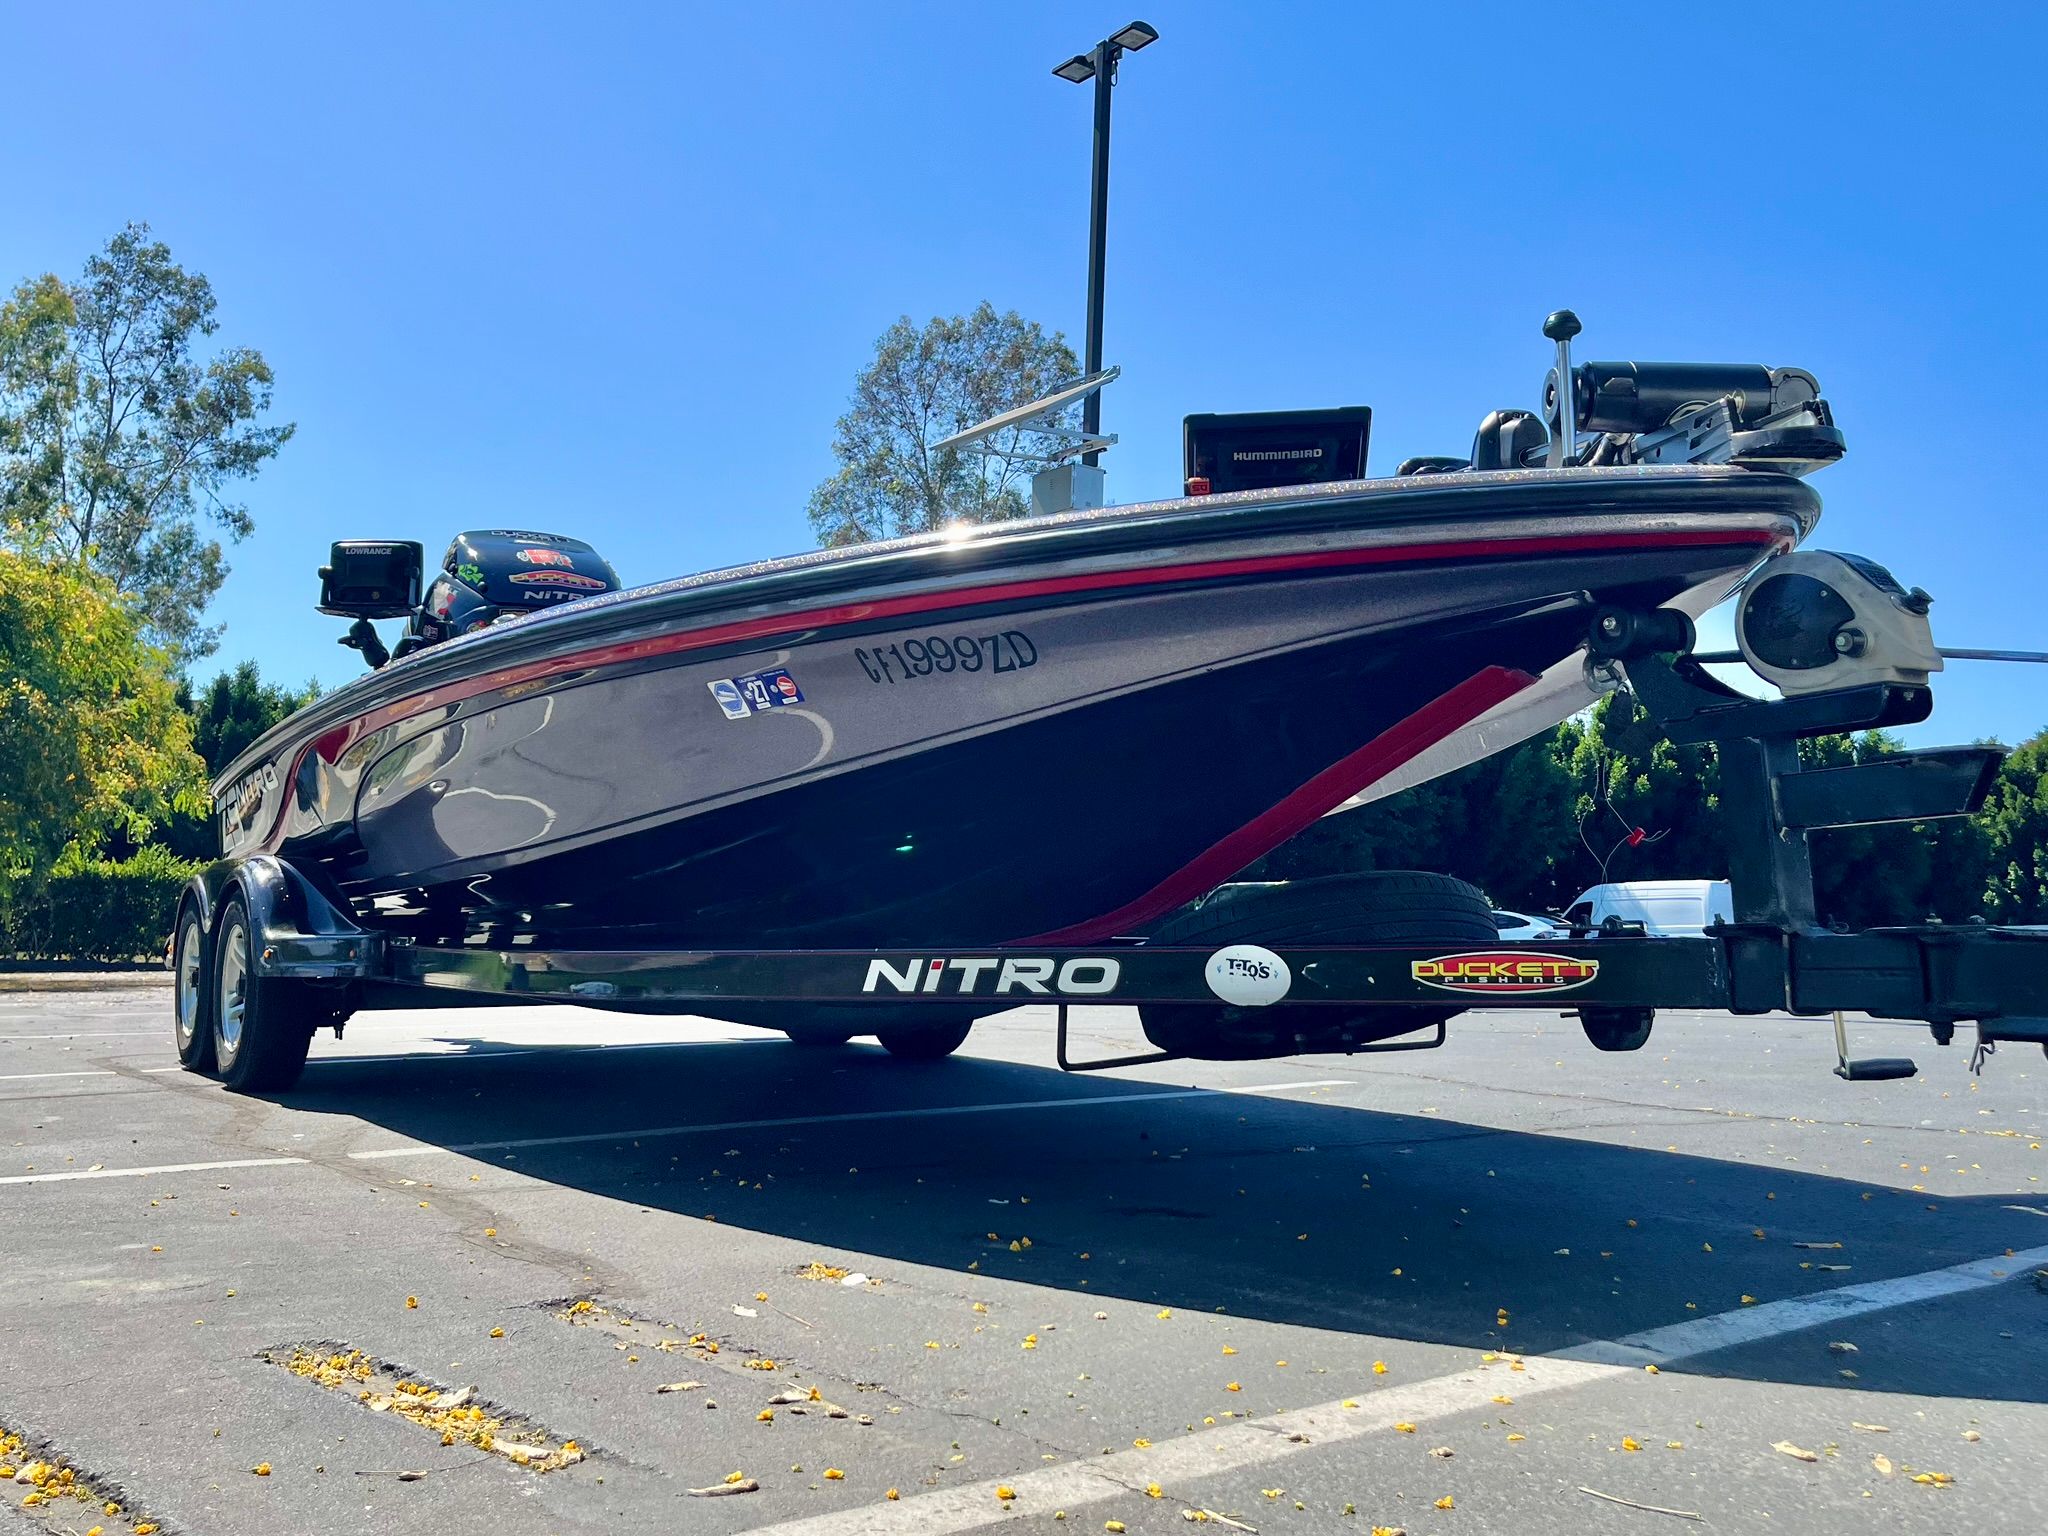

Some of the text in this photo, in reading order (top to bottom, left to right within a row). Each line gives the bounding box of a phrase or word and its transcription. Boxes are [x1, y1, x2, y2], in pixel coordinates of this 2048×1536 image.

[1233, 448, 1323, 461] HUMMINBIRD
[345, 547, 393, 555] LOWRANCE
[524, 590, 589, 600] NITR
[854, 630, 1038, 684] CF1999ZD
[747, 680, 770, 703] 27
[861, 958, 1122, 995] NITRO
[1414, 962, 1598, 977] DUCKETT
[1444, 976, 1565, 984] FISHING
